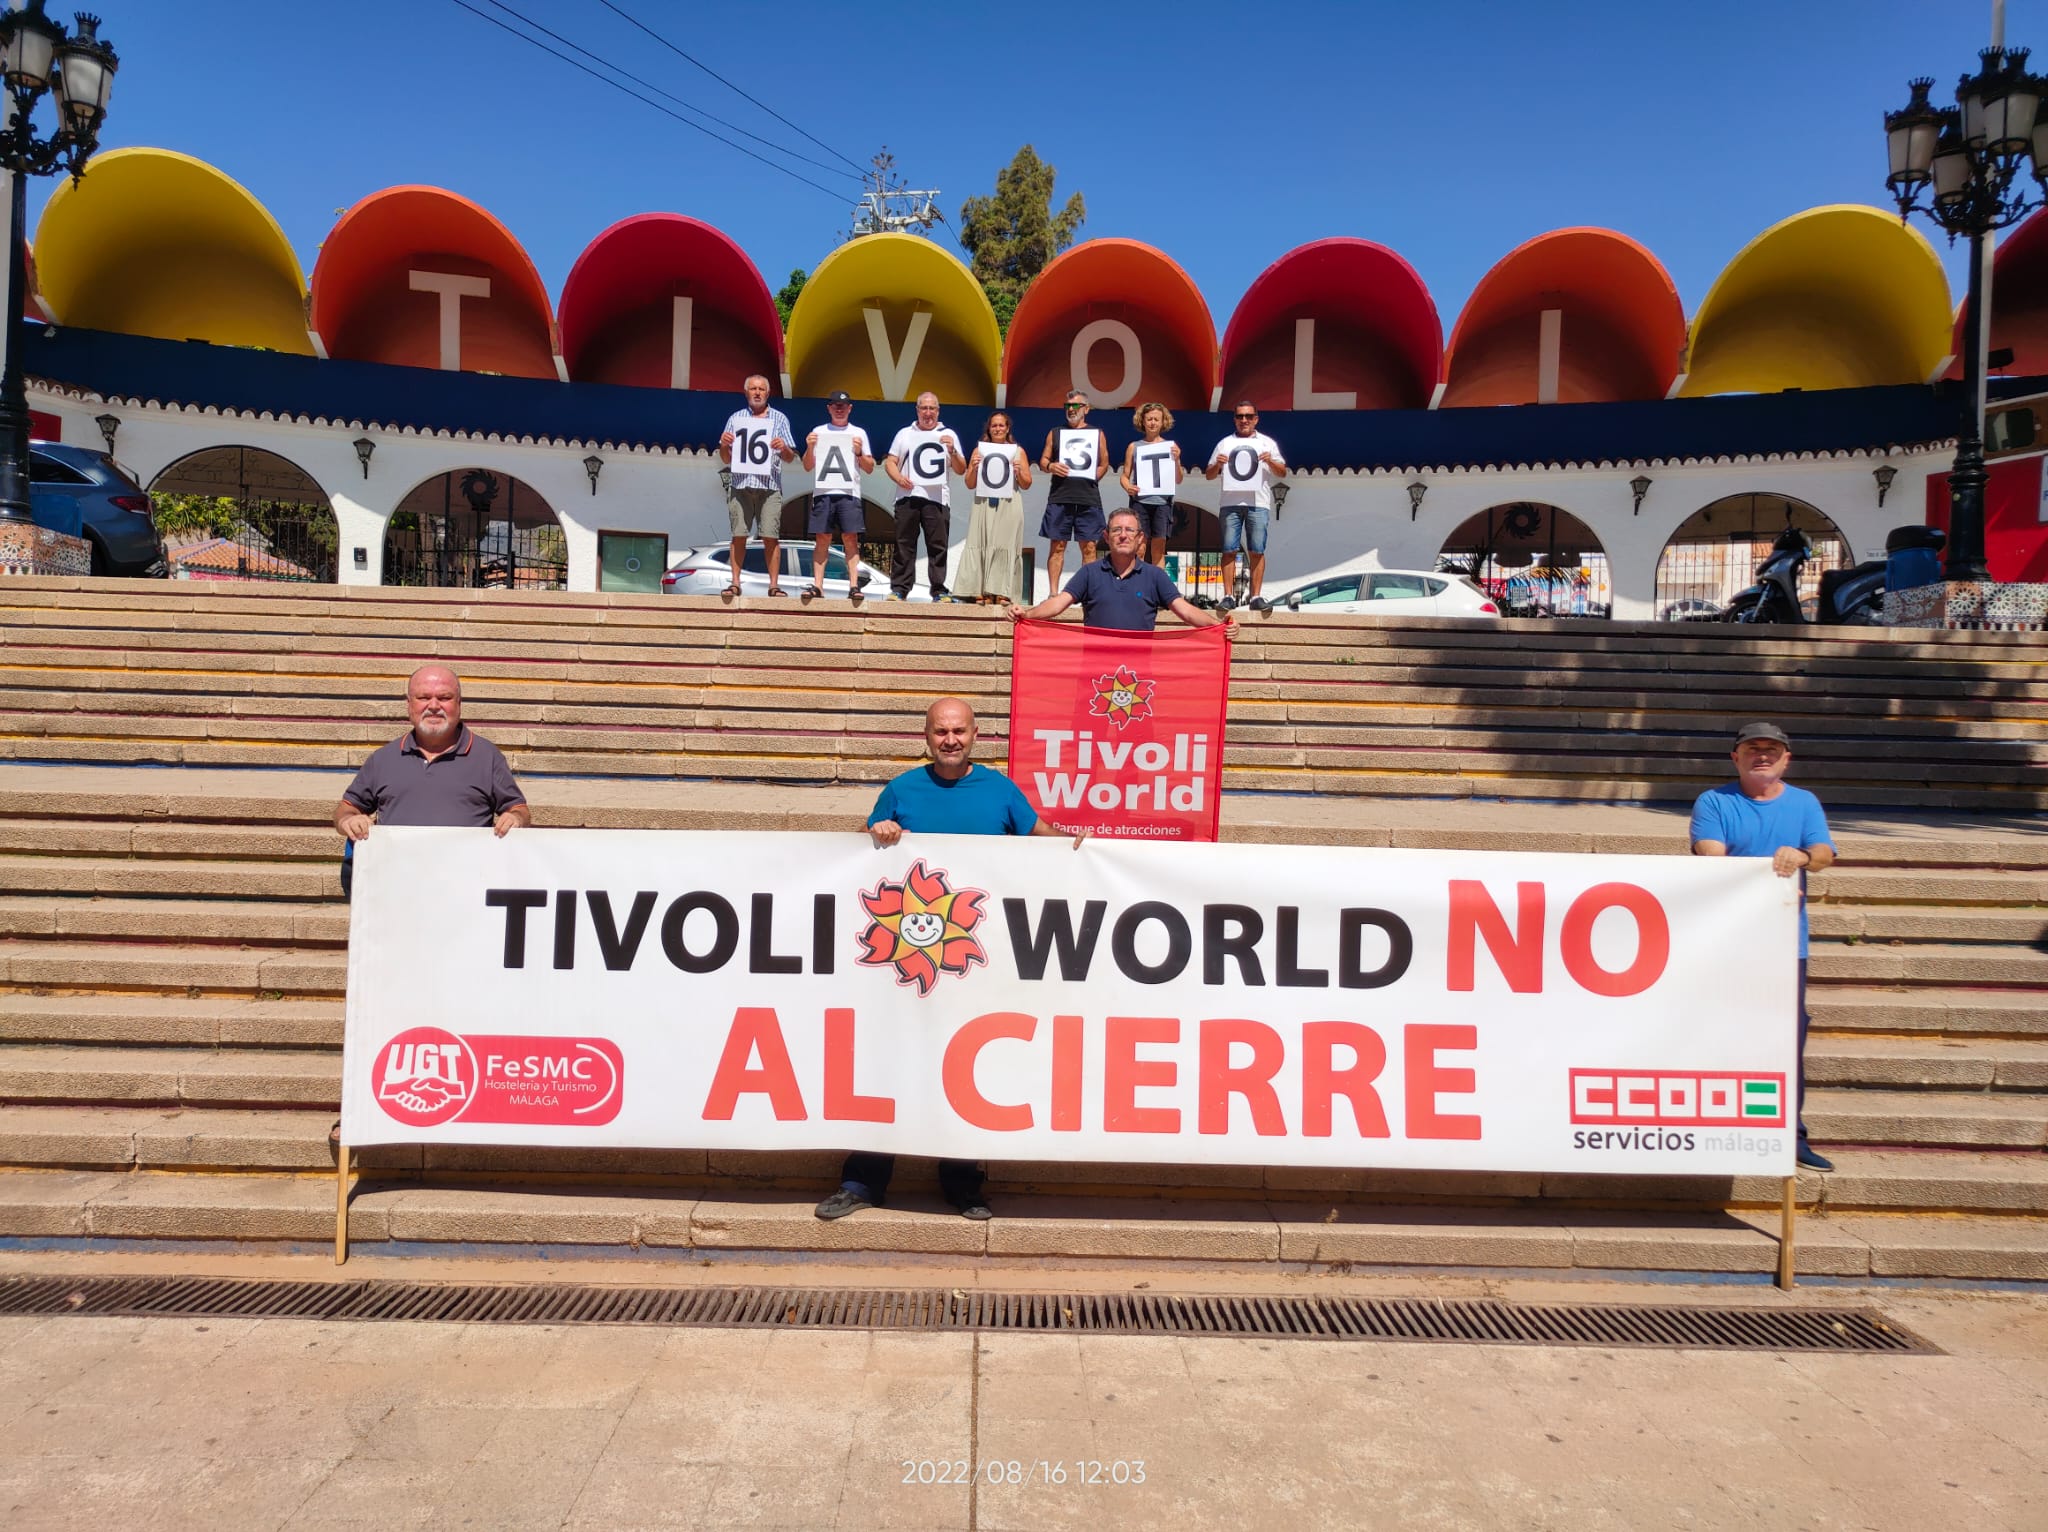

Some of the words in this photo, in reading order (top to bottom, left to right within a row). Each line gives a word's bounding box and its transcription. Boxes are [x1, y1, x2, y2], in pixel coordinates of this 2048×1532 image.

[735, 427, 769, 465] 16
[1033, 729, 1208, 772] Tivoli
[1033, 772, 1204, 812] World
[1096, 823, 1113, 835] de
[1114, 824, 1182, 836] atracciones
[485, 889, 836, 975] TIVOLI
[1003, 898, 1413, 989] WORLD
[1446, 879, 1670, 997] NO
[384, 1043, 462, 1082] UGT
[486, 1055, 593, 1080] FeSMC
[702, 1006, 896, 1124] AL
[941, 1012, 1482, 1141] CIERRE
[509, 1092, 560, 1106] MÁLAGA
[542, 1082, 550, 1094] y
[551, 1080, 598, 1093] Turismo
[1573, 1126, 1696, 1151] servicios
[1704, 1132, 1783, 1157] málaga
